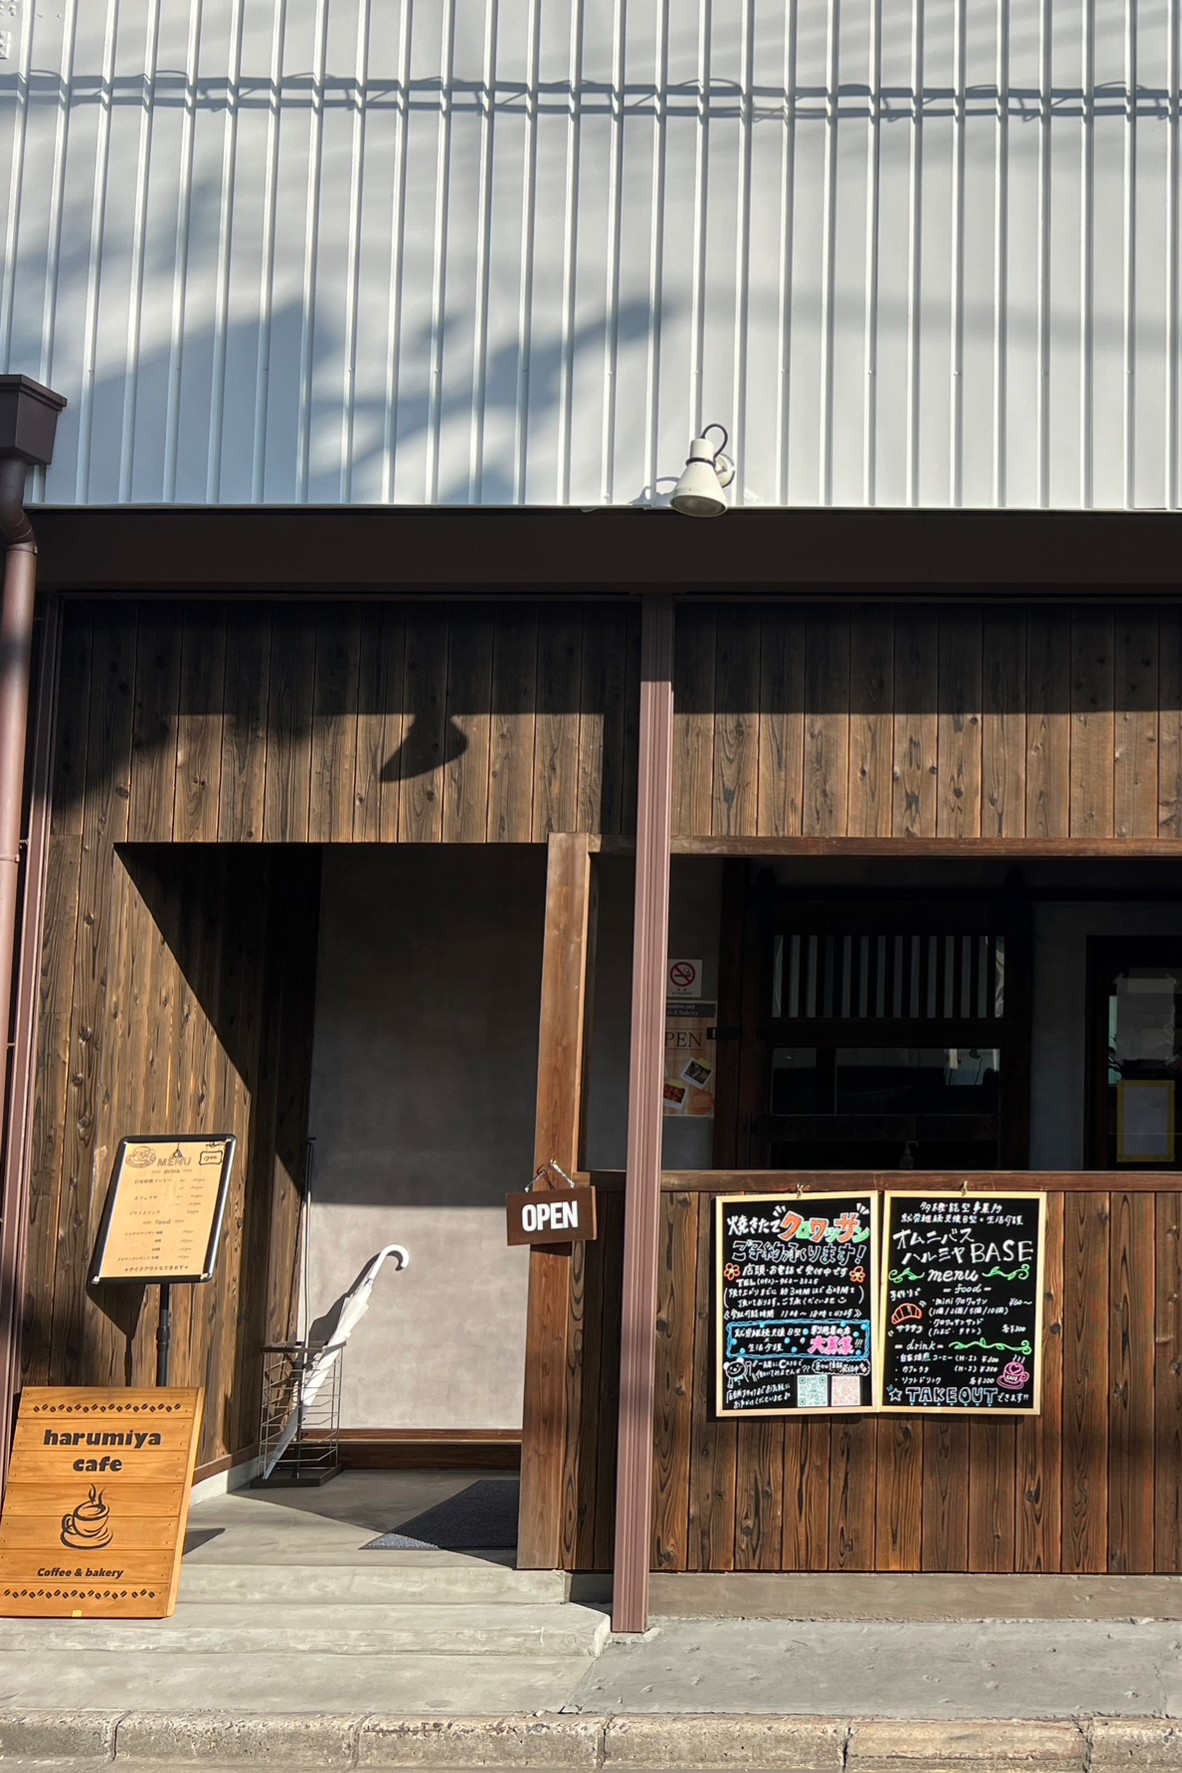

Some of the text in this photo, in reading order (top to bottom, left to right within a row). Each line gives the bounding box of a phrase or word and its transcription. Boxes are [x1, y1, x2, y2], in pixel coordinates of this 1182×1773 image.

[665, 1031, 703, 1047] PEN
[157, 1157, 192, 1167] MENU
[521, 1200, 579, 1232] OPEN
[892, 1228, 975, 1250] オムニバス
[927, 1268, 979, 1282] menu
[906, 1338, 936, 1350] drink
[43, 1429, 162, 1449] harumiya
[72, 1456, 123, 1472] cafe
[37, 1567, 124, 1580] Coffee & bakery
